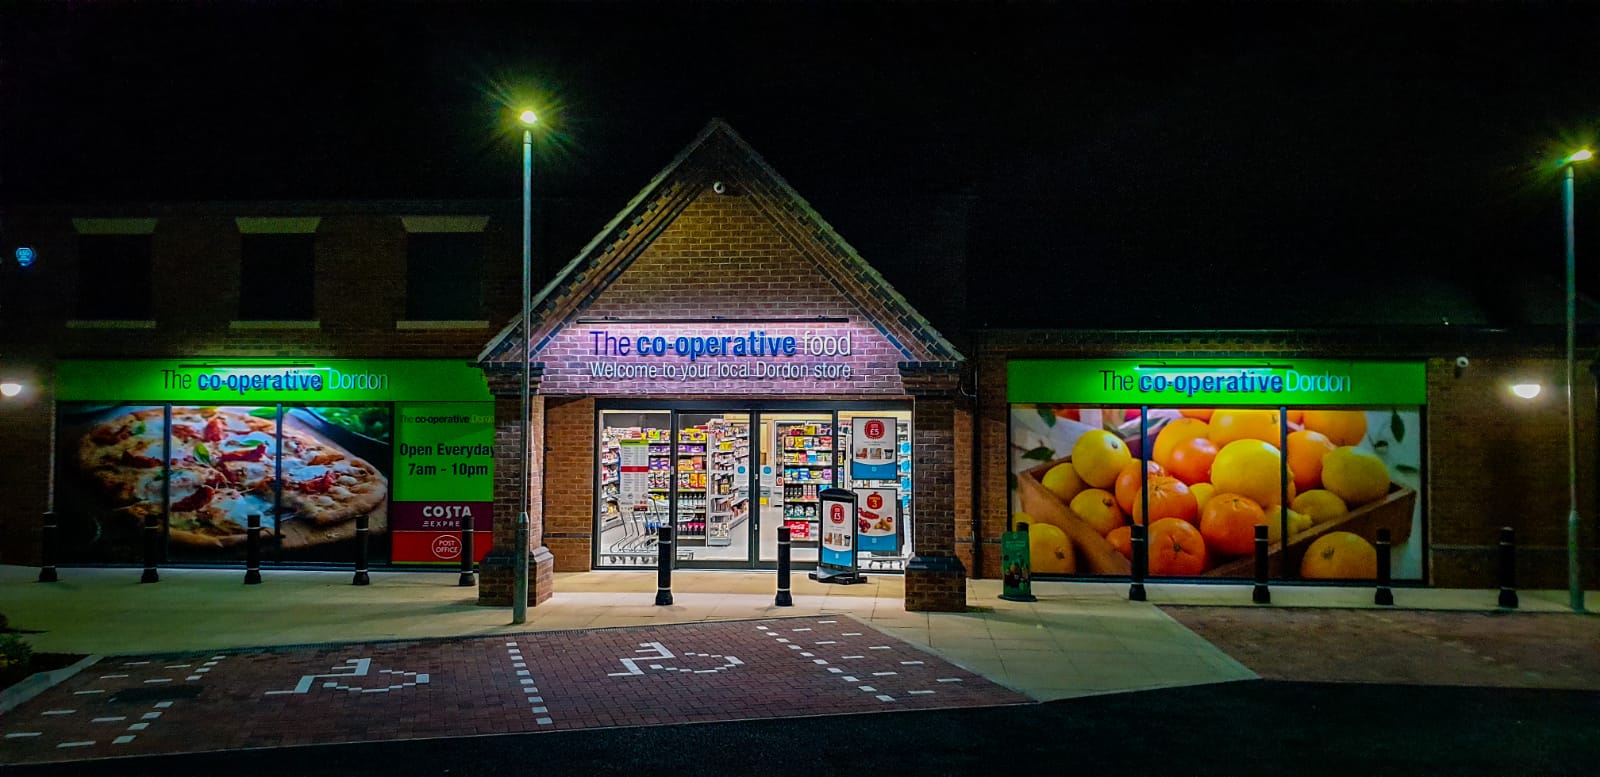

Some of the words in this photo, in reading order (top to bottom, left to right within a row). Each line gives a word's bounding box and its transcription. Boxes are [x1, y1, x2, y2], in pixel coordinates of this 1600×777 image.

[589, 330, 631, 356] The
[636, 331, 797, 361] co-operative
[802, 331, 852, 356] food
[590, 361, 657, 378] Welcome
[663, 362, 676, 378] to
[680, 364, 713, 381] your
[717, 361, 750, 378] local
[756, 361, 809, 378] Dordon
[814, 362, 851, 378] store
[160, 369, 191, 390] The
[197, 371, 323, 395] co-operative
[328, 369, 389, 390] Dordon
[1099, 369, 1134, 391] The
[1138, 371, 1283, 397] co-operative
[1286, 370, 1351, 392] Dordon
[400, 443, 432, 458] Open
[437, 443, 495, 458] Everyday
[408, 463, 436, 475] 7am
[452, 463, 488, 477] 10pm
[423, 505, 472, 519] COSTA
